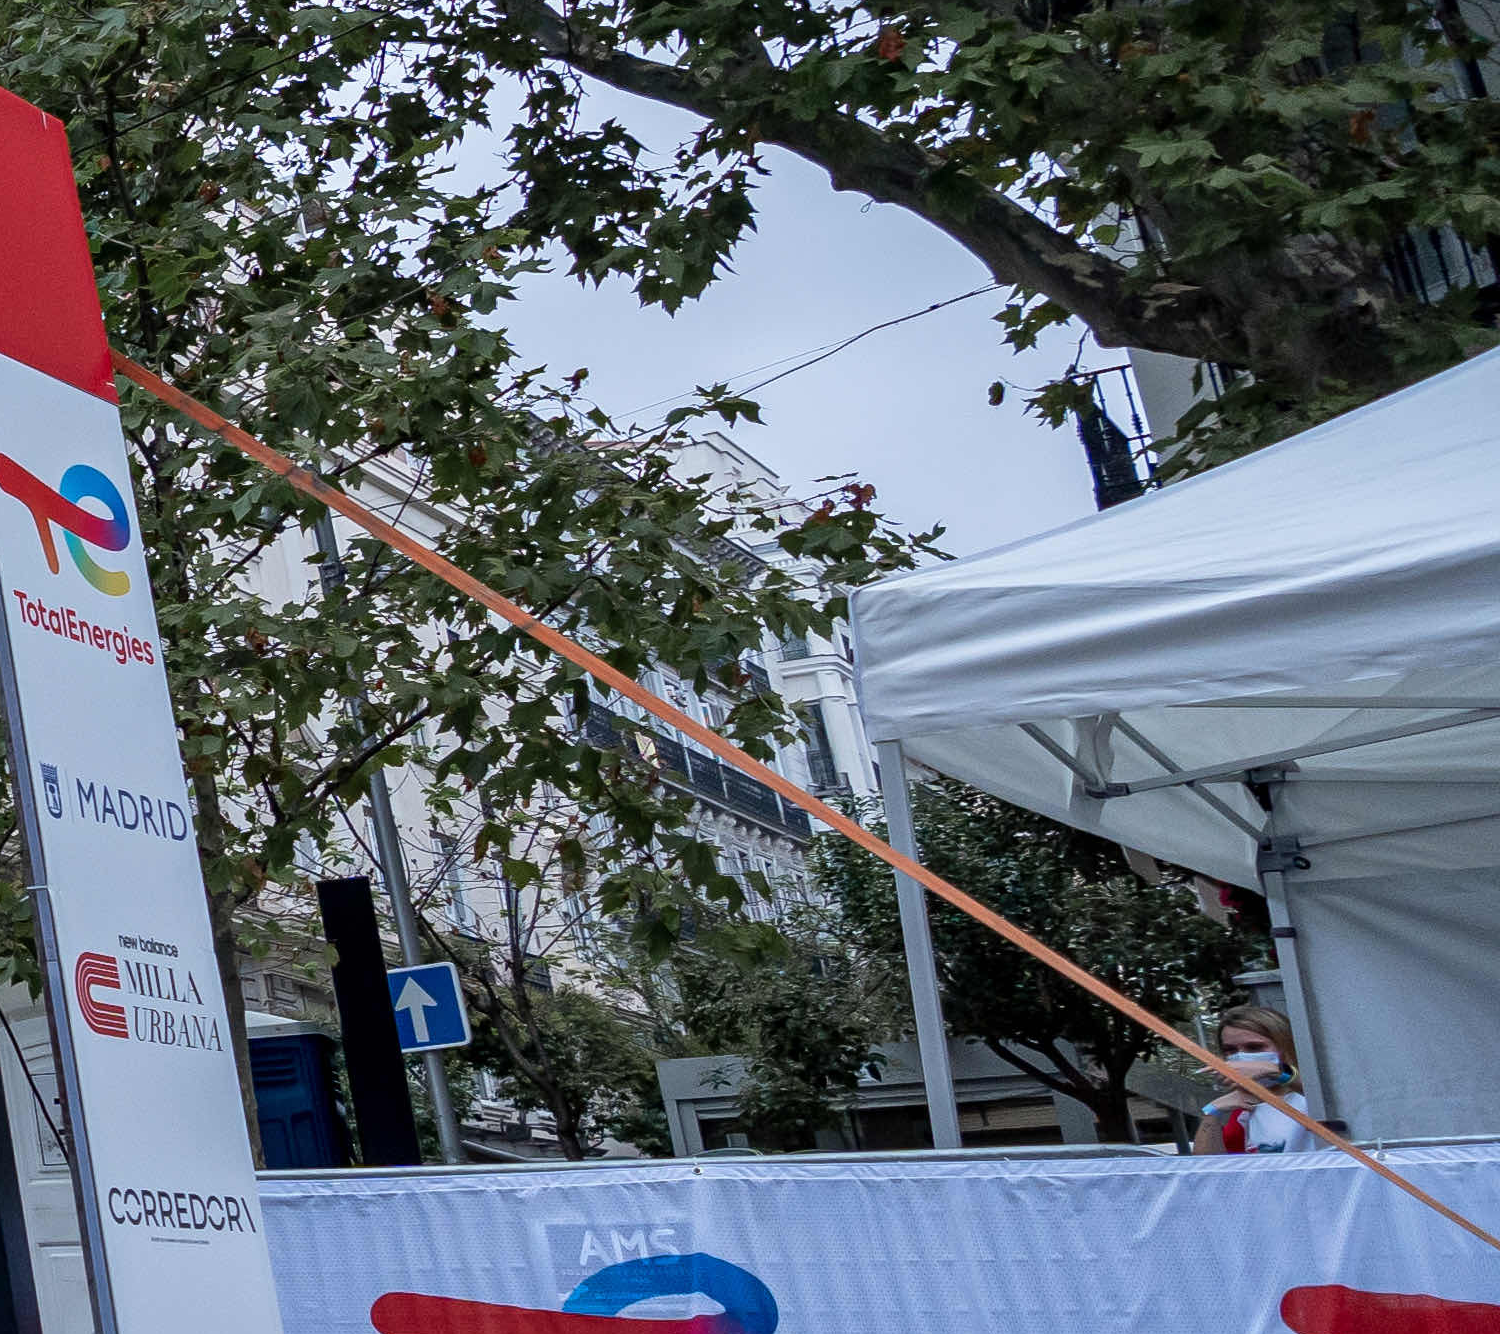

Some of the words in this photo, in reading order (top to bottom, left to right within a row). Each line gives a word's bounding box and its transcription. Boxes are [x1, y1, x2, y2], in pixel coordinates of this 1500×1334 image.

[13, 589, 155, 665] TotalEnergies
[76, 778, 188, 841] MADRID
[118, 933, 137, 949] new
[139, 935, 179, 958] balance
[123, 959, 205, 1006] MILLA
[132, 1005, 225, 1052] URBANA
